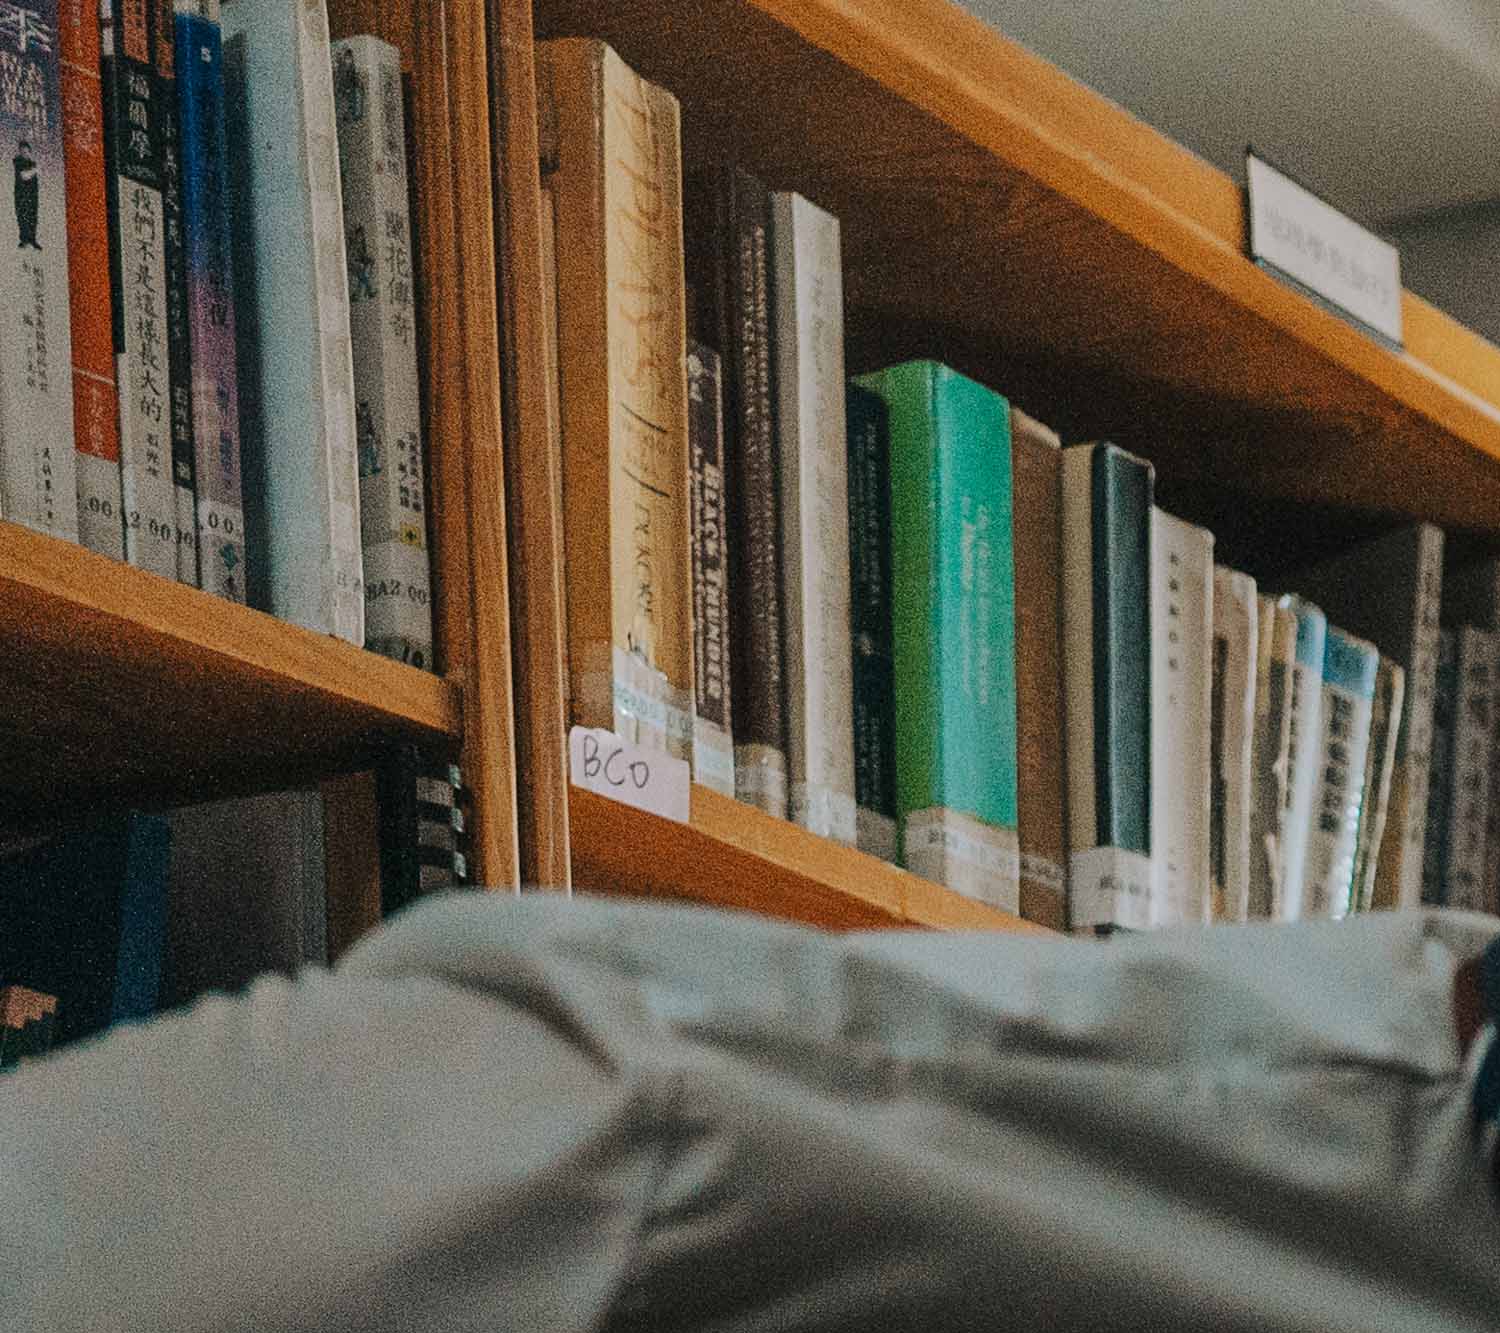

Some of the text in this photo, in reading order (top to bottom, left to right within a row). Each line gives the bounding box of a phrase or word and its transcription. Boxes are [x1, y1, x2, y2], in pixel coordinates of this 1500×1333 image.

[130, 187, 162, 423] 我們不是這樣長大的
[703, 461, 724, 700] BLACK THUNDER
